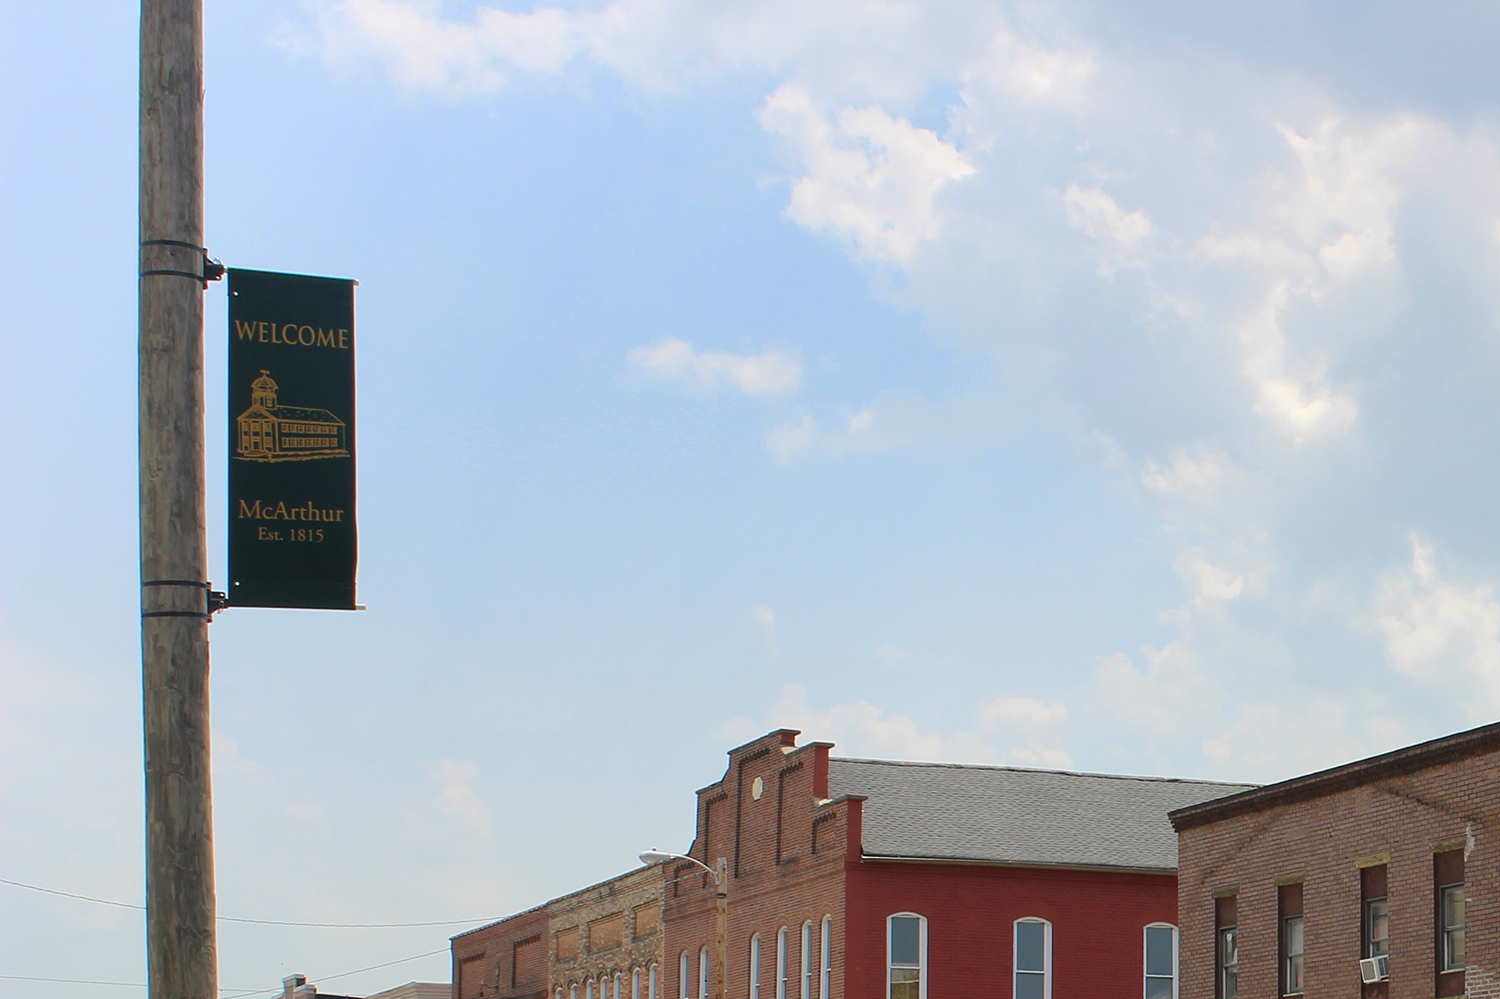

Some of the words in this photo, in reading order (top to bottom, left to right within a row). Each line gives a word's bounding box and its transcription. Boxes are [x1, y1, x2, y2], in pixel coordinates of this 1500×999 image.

[234, 319, 349, 349] WELCOME
[238, 498, 344, 522] McArthur
[257, 526, 283, 541] Est.
[290, 528, 324, 543] 1815
